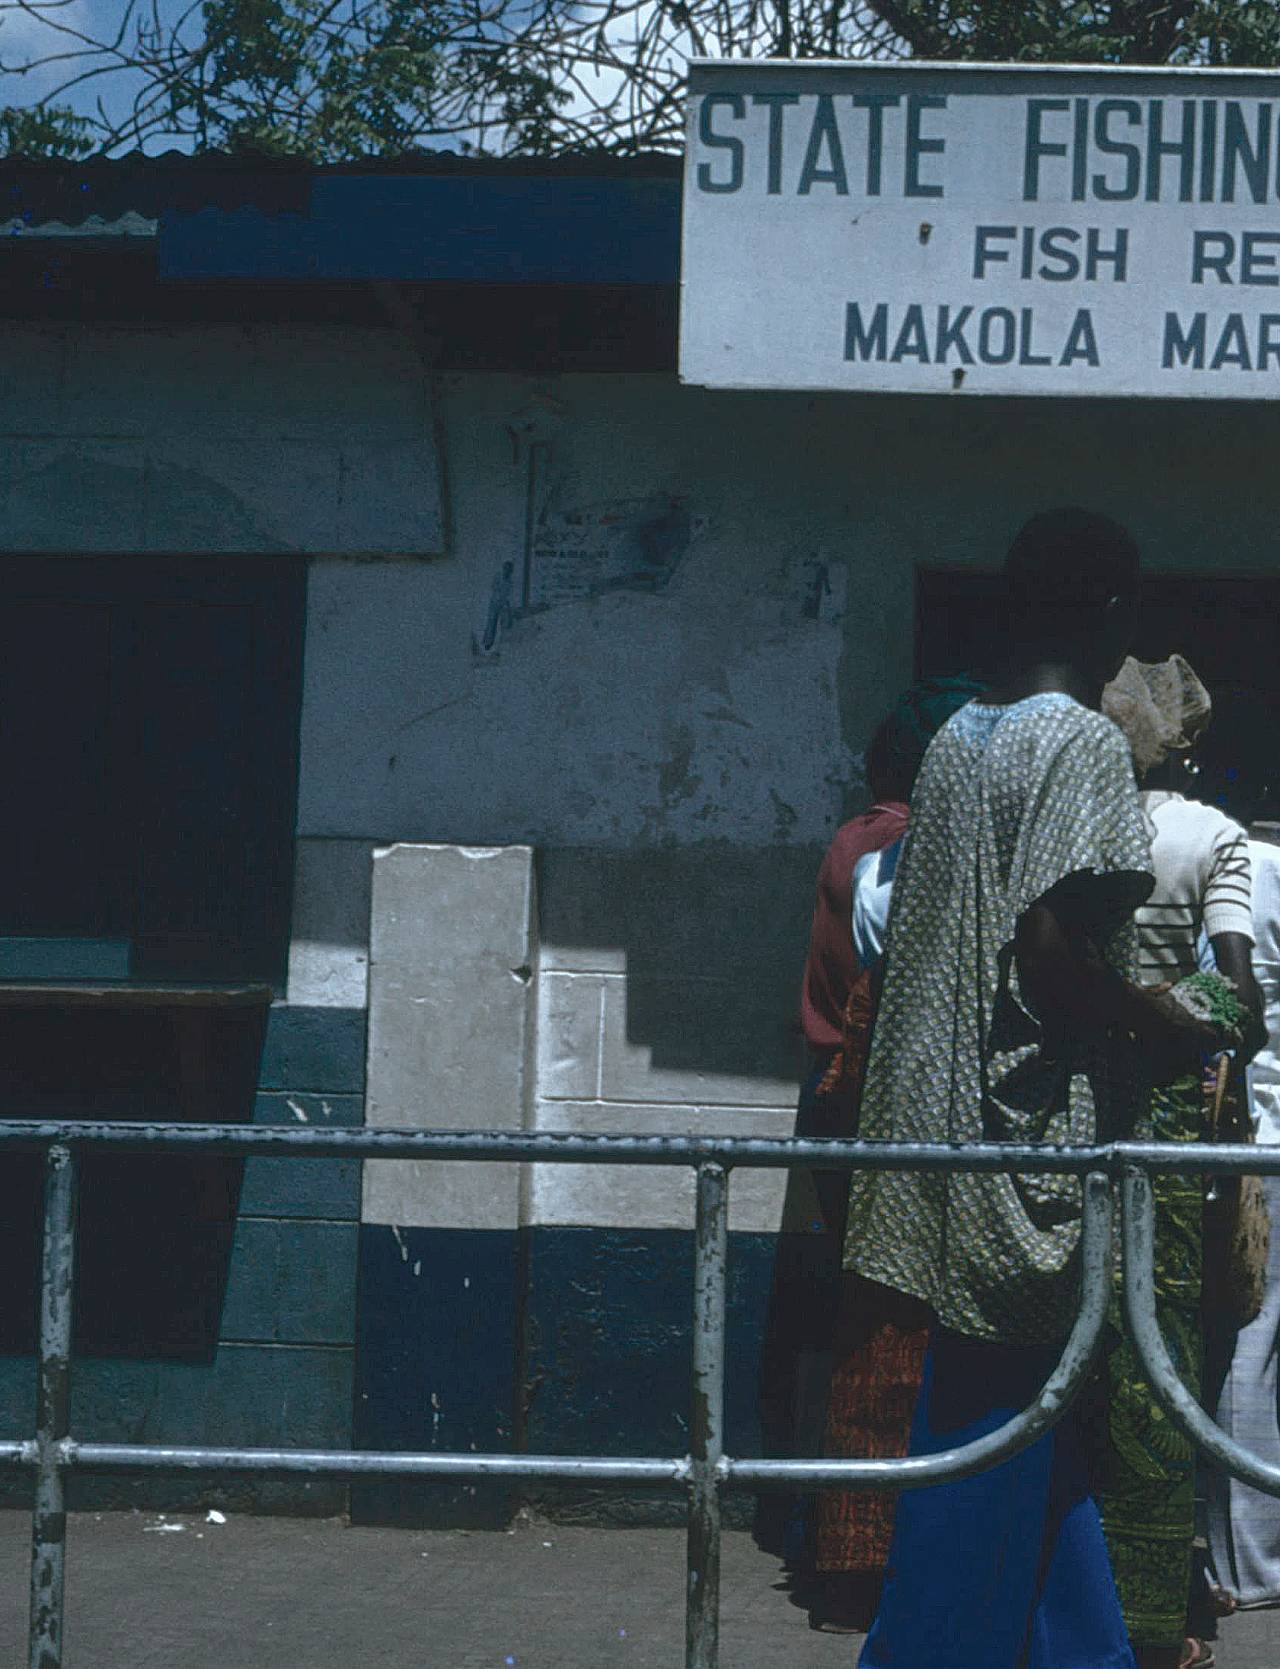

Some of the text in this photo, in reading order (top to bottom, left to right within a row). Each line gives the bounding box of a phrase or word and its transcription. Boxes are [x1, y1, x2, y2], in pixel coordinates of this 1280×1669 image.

[696, 92, 948, 198] STATE
[973, 225, 1129, 283] FISH
[843, 301, 1101, 367] MAKOLA
